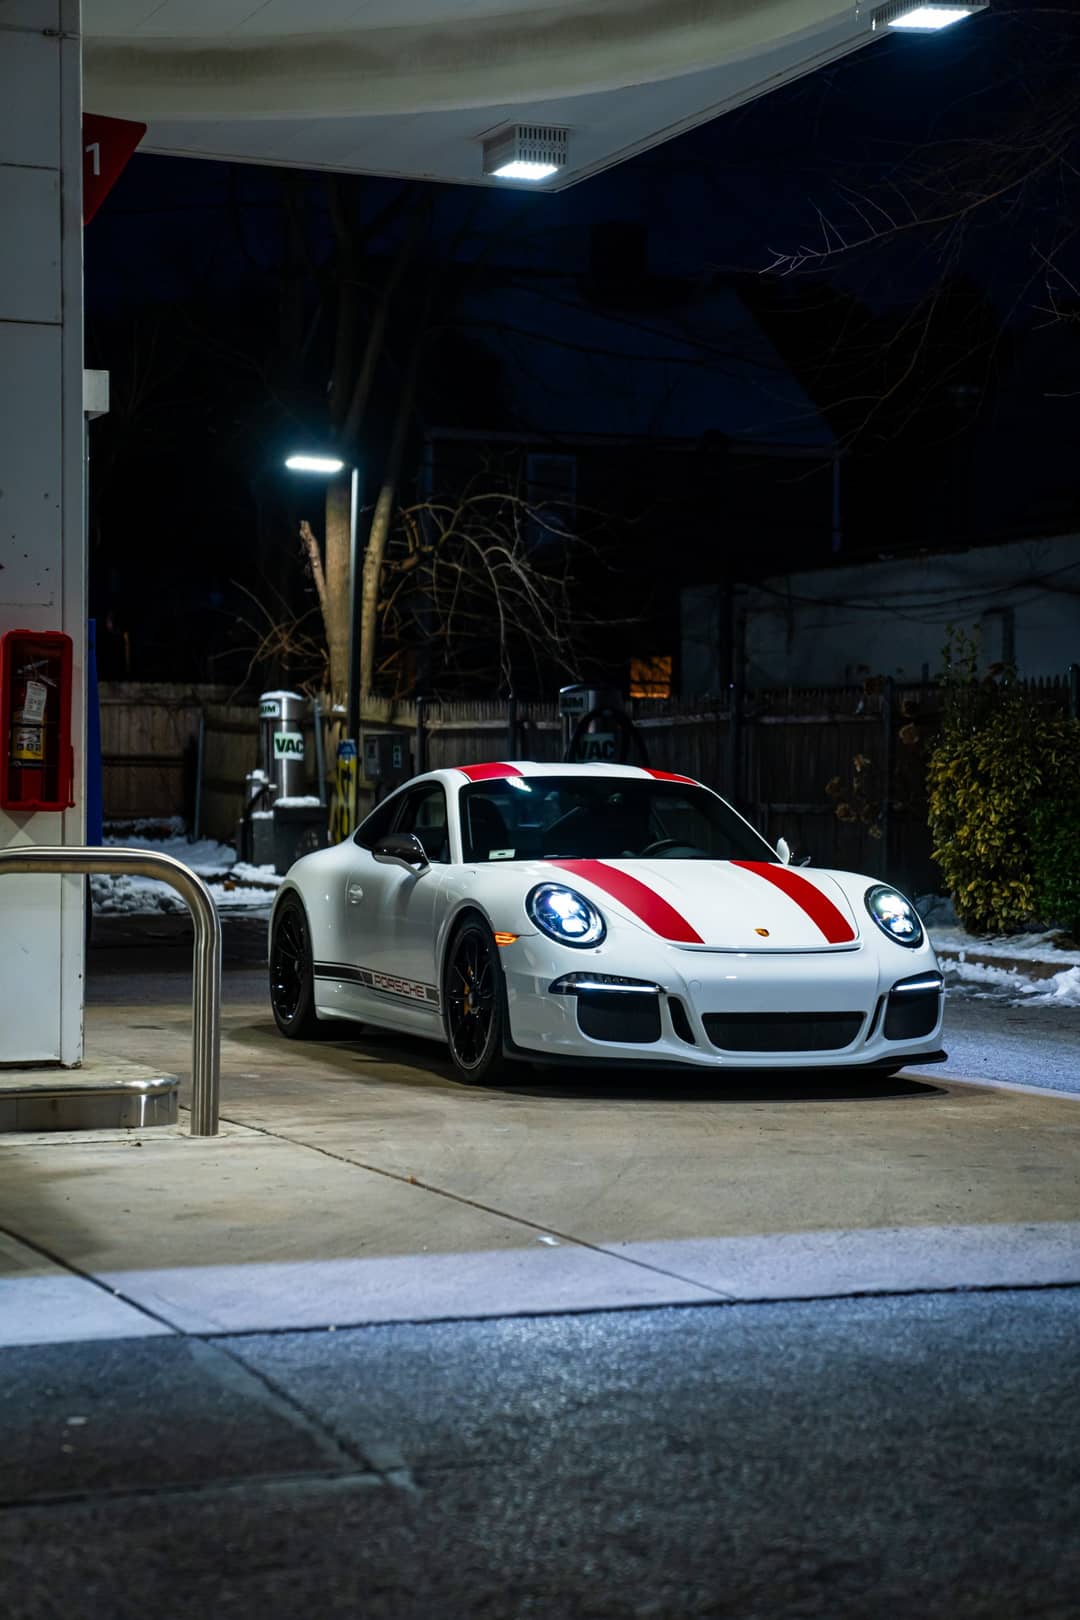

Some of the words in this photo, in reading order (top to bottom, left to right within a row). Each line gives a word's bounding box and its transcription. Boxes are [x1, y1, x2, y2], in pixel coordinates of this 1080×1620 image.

[85, 142, 100, 176] 1
[275, 738, 304, 753] VAC
[576, 740, 616, 759] VAC
[374, 974, 425, 998] PORSCHE
